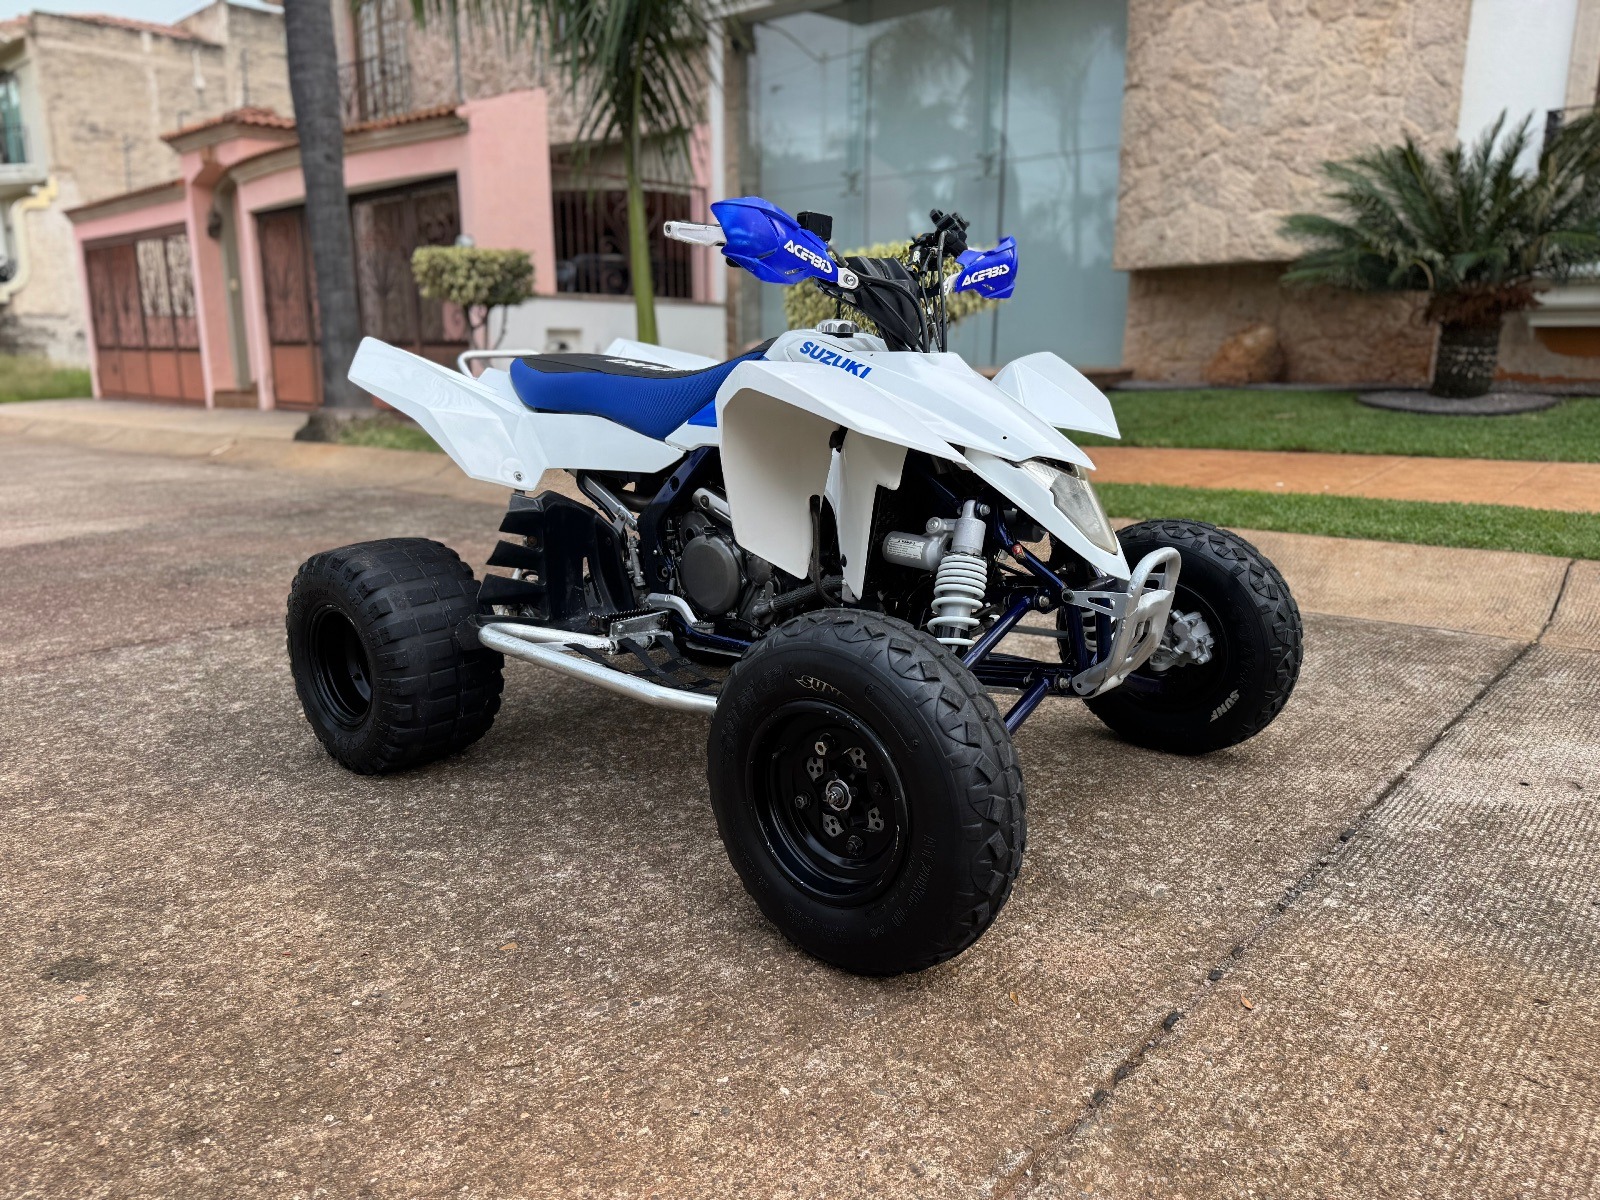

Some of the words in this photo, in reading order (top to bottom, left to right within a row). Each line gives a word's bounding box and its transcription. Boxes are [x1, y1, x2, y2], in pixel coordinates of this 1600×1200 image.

[783, 240, 832, 273] ACERBIS
[961, 264, 1010, 287] ACERBIS
[799, 341, 873, 379] SUZUKI
